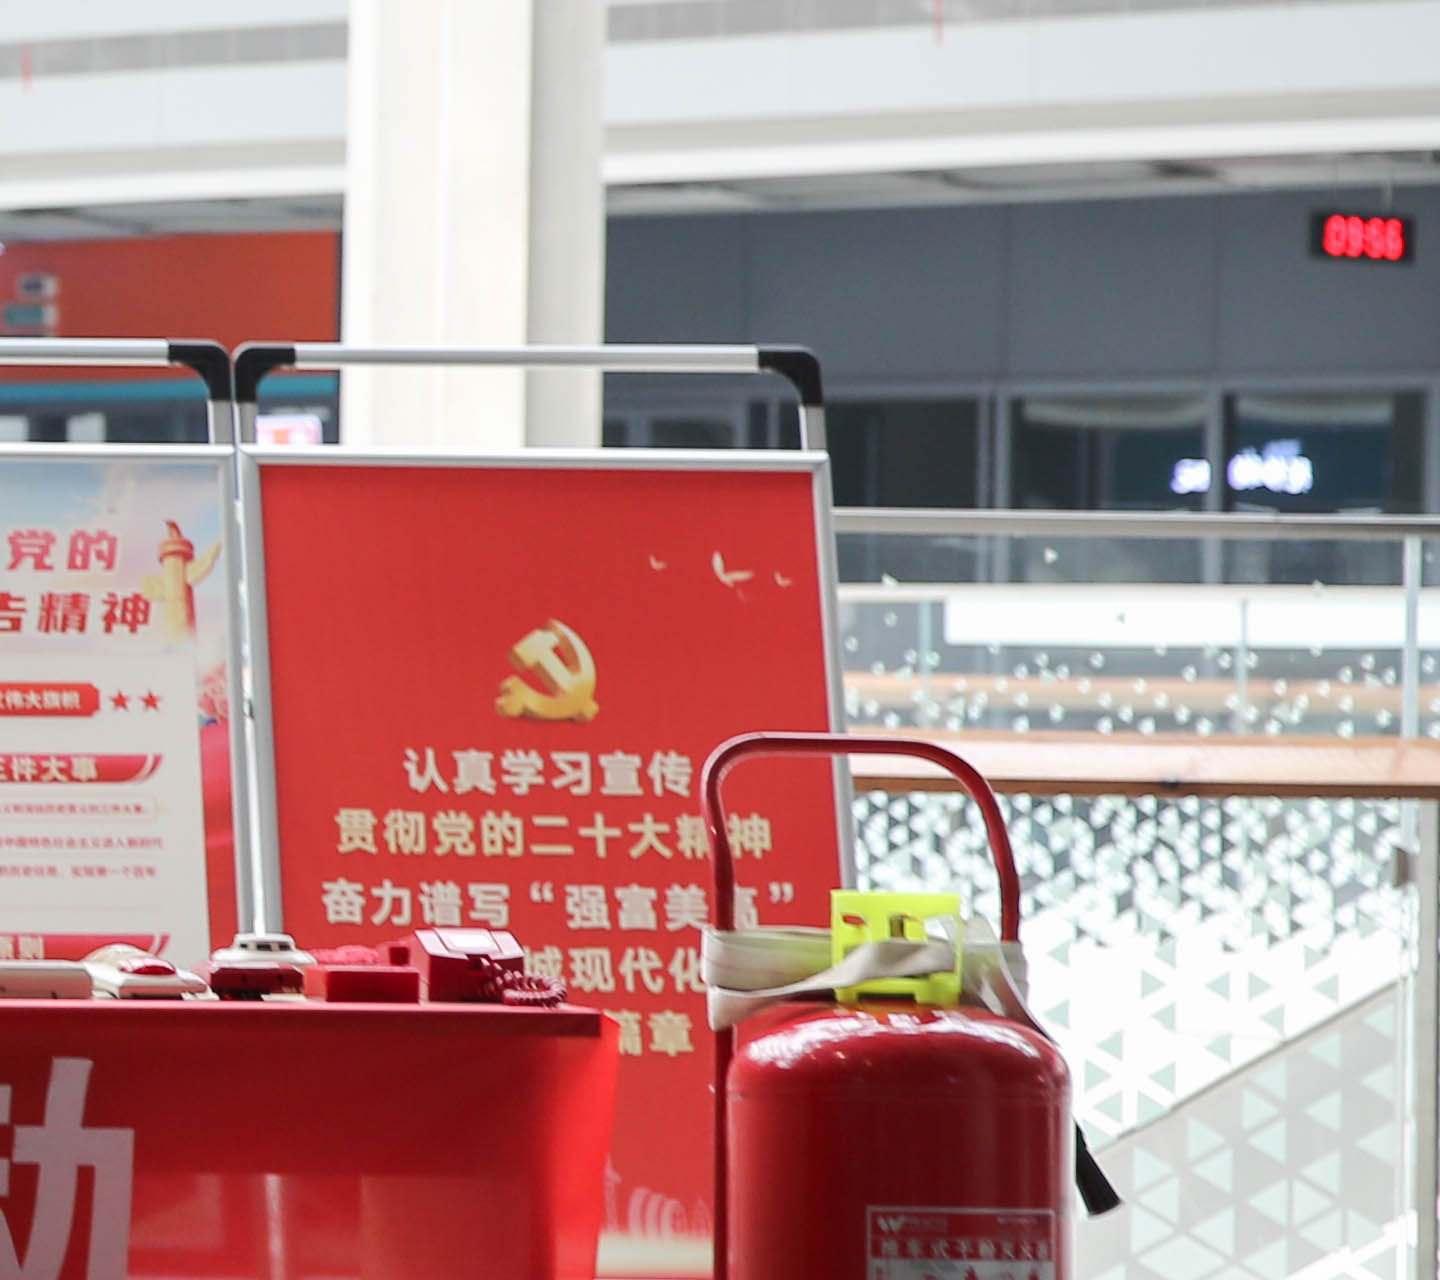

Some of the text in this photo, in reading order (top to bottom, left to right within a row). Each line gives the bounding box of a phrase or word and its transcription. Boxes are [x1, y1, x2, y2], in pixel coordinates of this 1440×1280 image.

[402, 746, 694, 799] 认真学习宣传
[333, 807, 773, 859] 贯彻党的二十大精神
